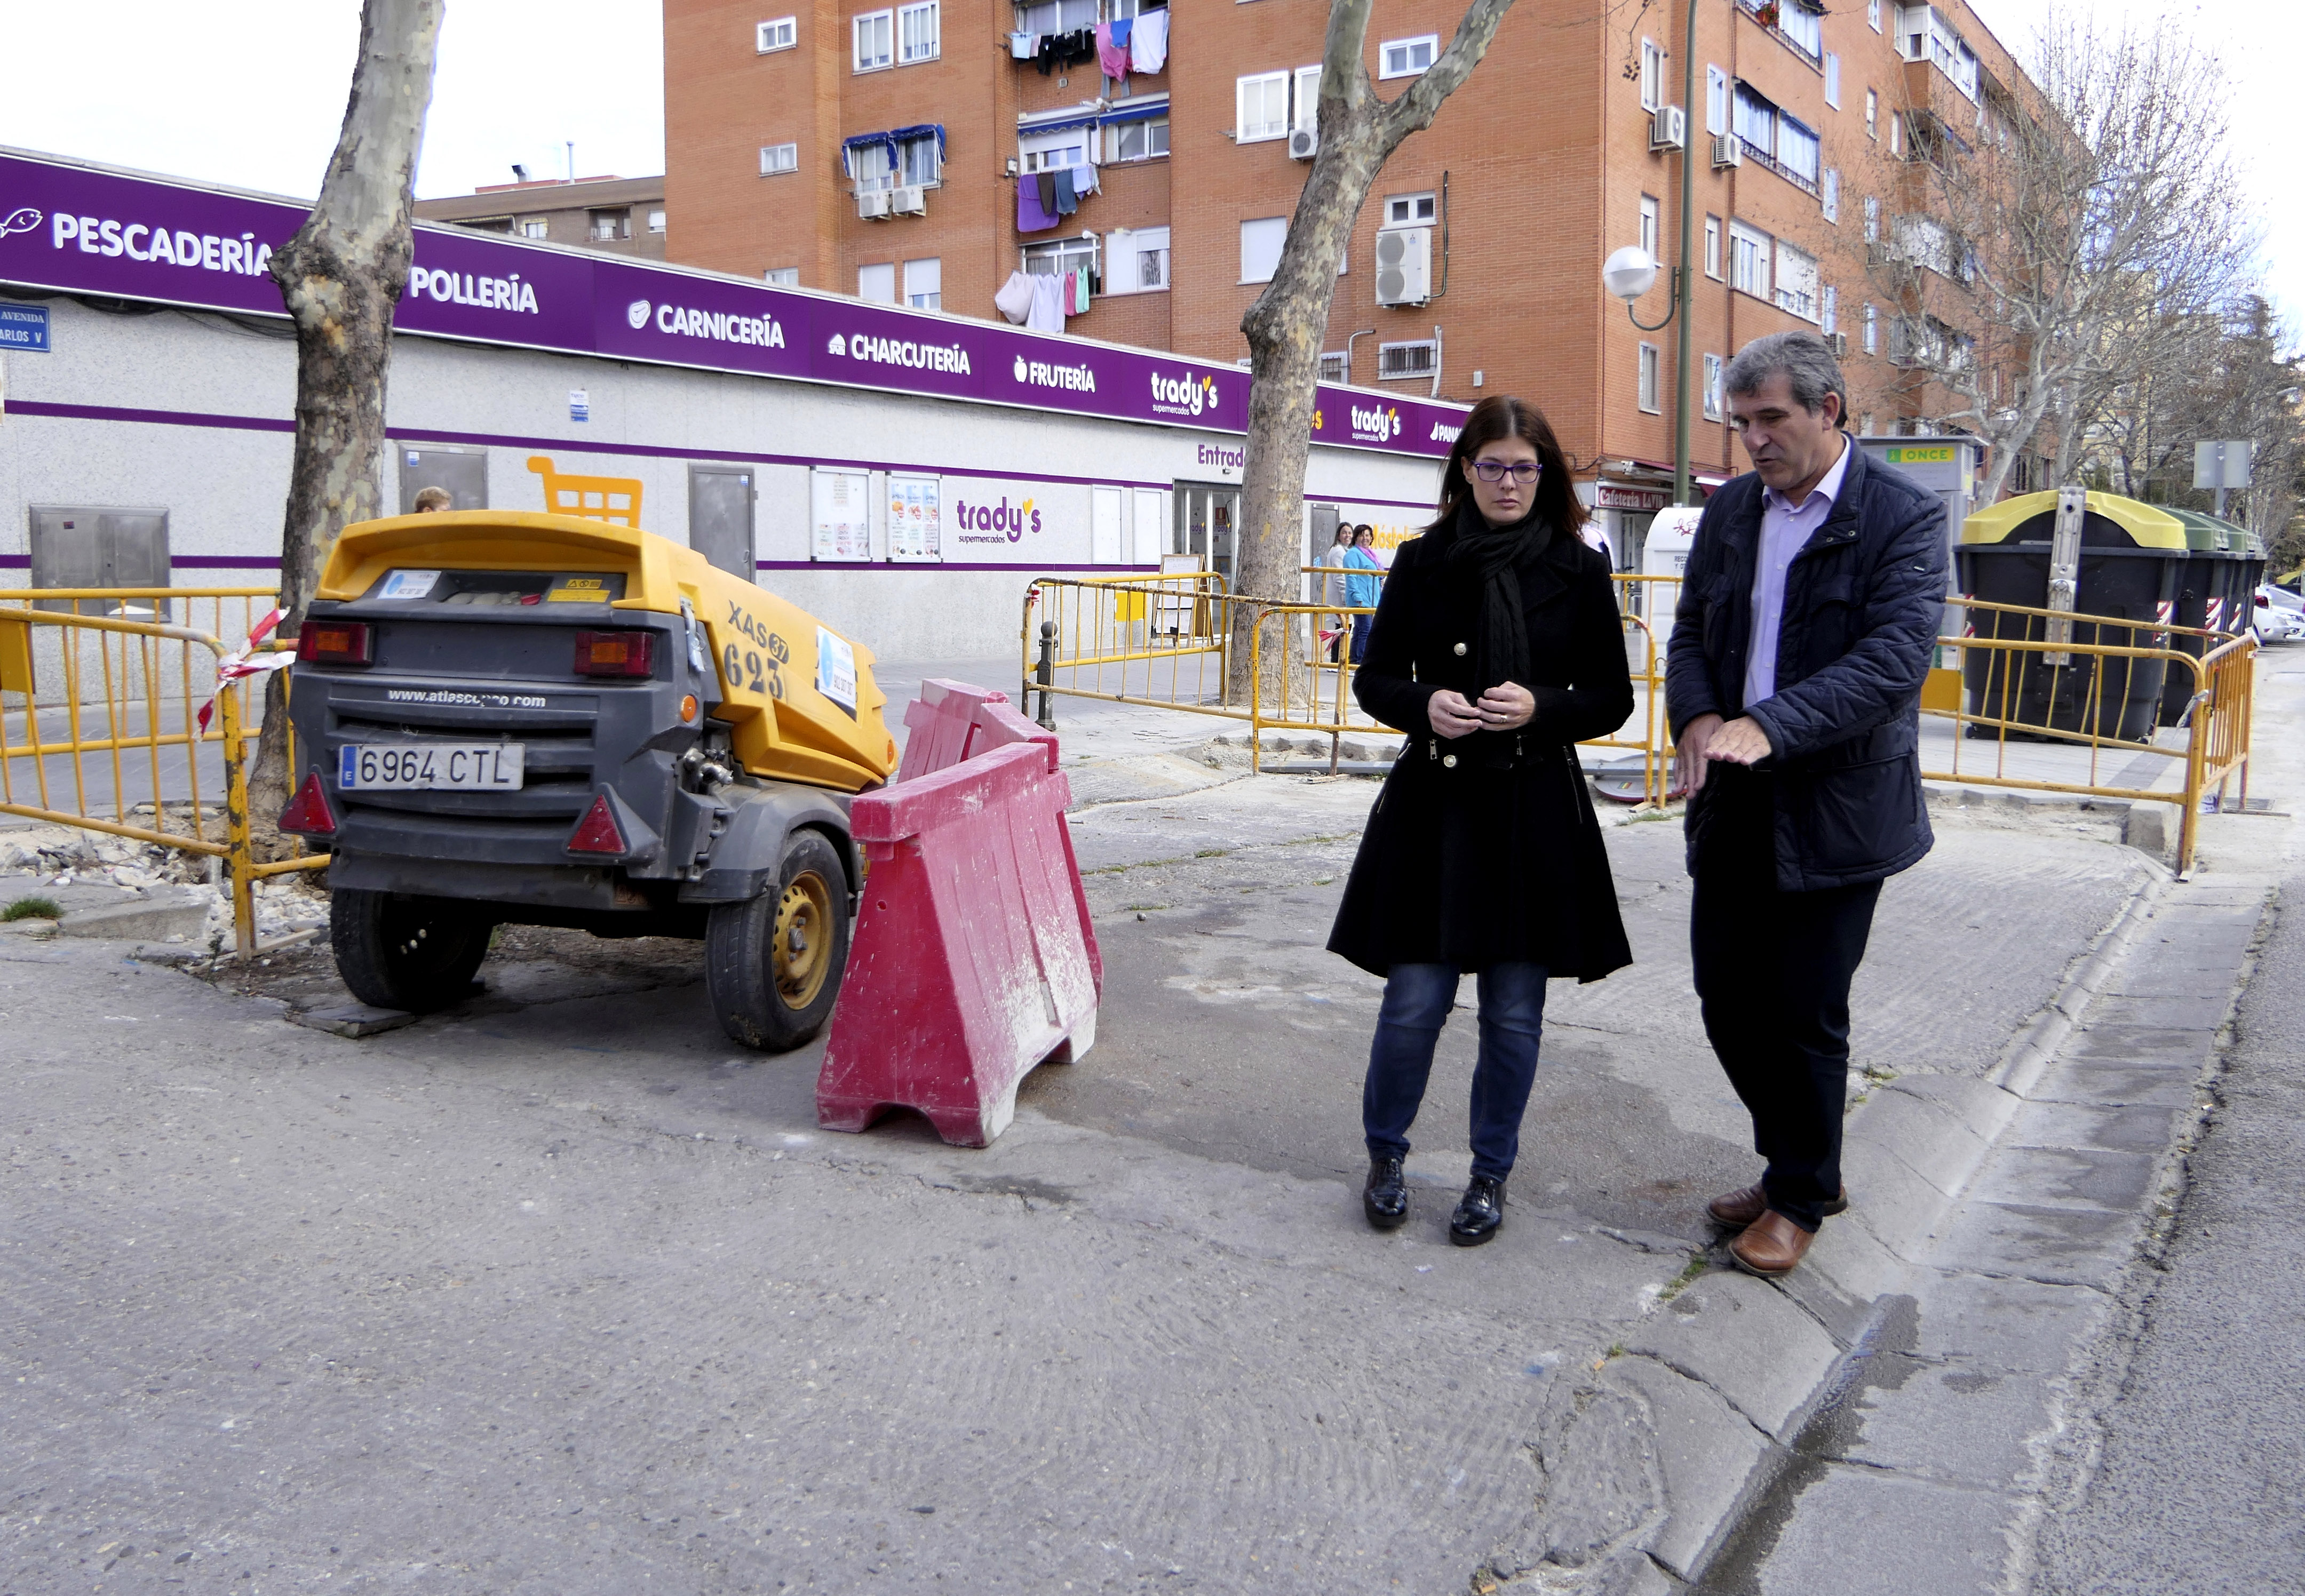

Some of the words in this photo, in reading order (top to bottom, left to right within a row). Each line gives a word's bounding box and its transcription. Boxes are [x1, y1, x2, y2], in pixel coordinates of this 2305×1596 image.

[53, 213, 273, 276] PESCADERÍA
[411, 266, 539, 314] POLLERÍA
[1, 311, 44, 323] AVENIDA
[657, 305, 785, 349] CARNICERÍA
[0, 329, 29, 342] ARLOS
[35, 332, 42, 343] V
[852, 334, 971, 376] CHARCUTERÍA
[1030, 362, 1095, 393] FRUTERÍA
[1151, 372, 1218, 416] trady's
[1152, 404, 1190, 416] supermercados
[1351, 404, 1401, 442] trady's
[1438, 425, 1462, 443] PANA
[1198, 444, 1245, 468] Entrad
[1906, 450, 1948, 460] ONCE
[957, 496, 1042, 543] trady's
[959, 534, 1005, 545] supermercados
[728, 599, 767, 648] XAS
[771, 636, 788, 660] 37
[724, 643, 784, 700] 623
[345, 771, 352, 780] E
[361, 749, 436, 783] 6964
[450, 749, 510, 783] CTL
